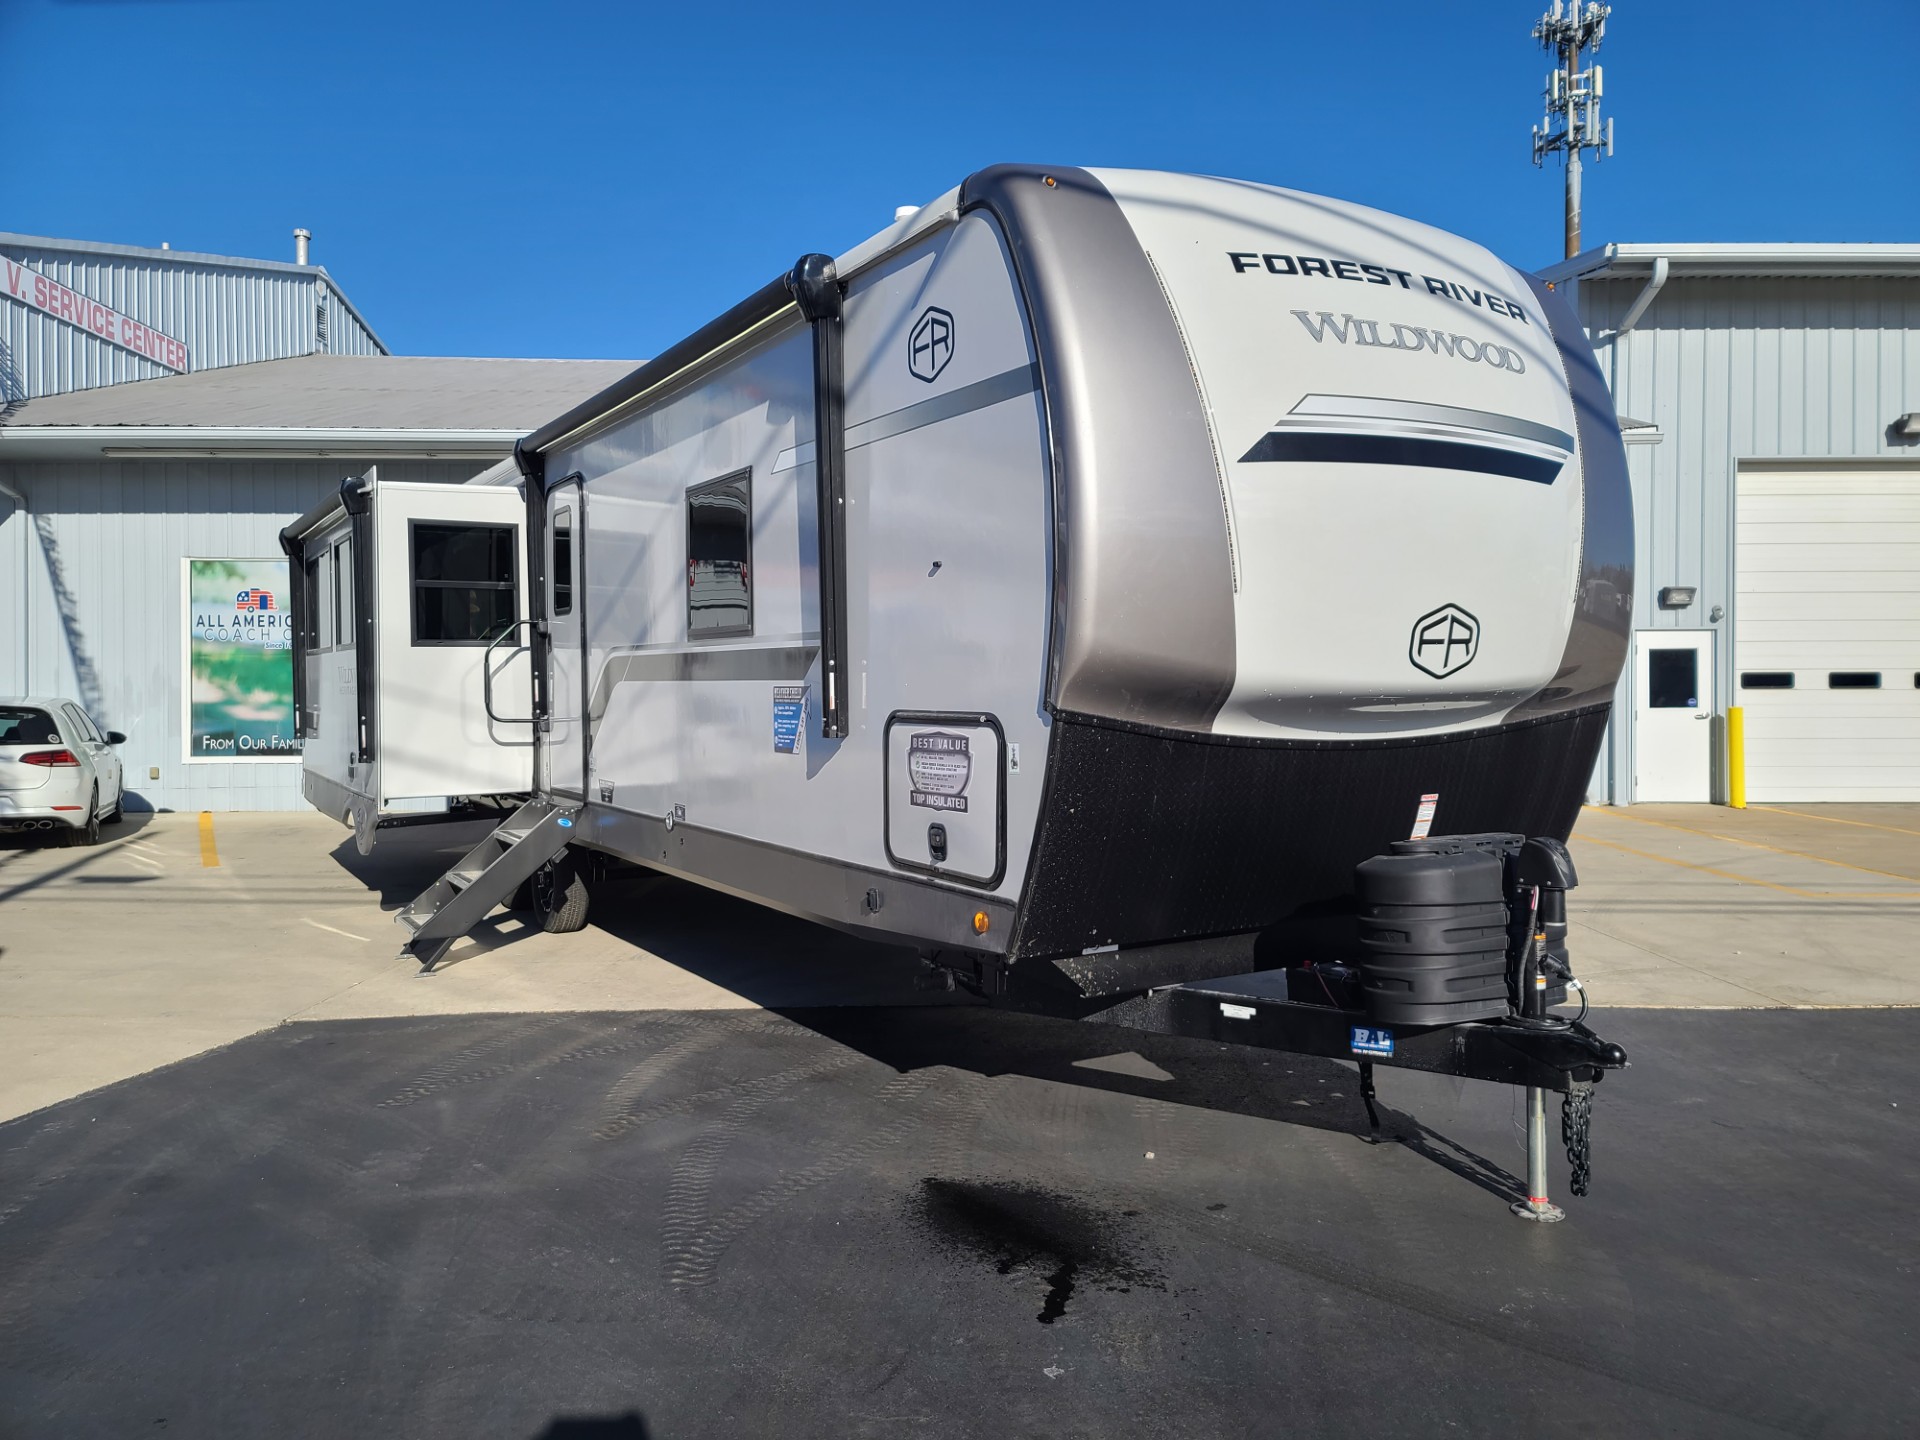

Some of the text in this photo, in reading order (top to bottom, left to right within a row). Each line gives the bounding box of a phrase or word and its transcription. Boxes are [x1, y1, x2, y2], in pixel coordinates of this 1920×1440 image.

[1226, 252, 1529, 325] FOREST RIVER
[34, 275, 115, 341] SERVICE
[121, 318, 187, 371] CENTER
[1290, 310, 1526, 375] WILDWOOD
[196, 614, 225, 628] ALL
[204, 628, 270, 641] COACH
[265, 641, 283, 650] Since
[912, 737, 967, 751] BEST VALUE
[912, 793, 966, 809] TOP INSULATED
